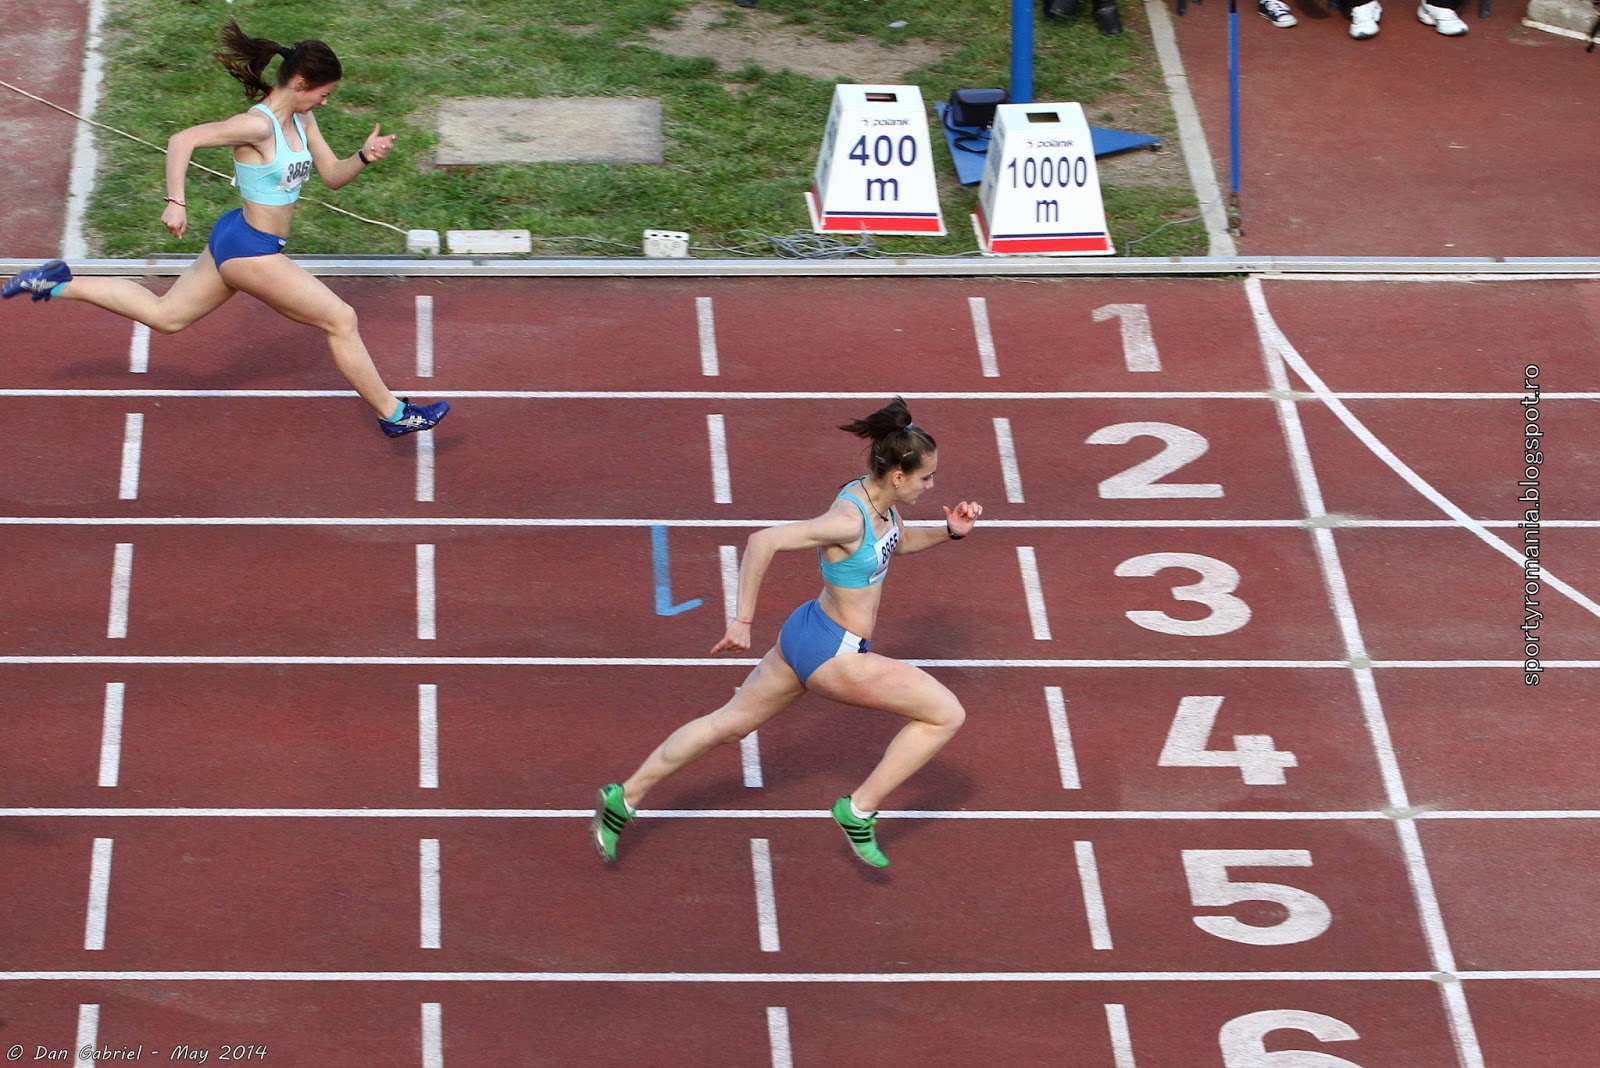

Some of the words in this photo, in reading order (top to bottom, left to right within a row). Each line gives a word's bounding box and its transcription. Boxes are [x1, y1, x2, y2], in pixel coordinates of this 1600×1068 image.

[287, 160, 311, 183] 386
[849, 135, 917, 167] 400
[1008, 156, 1087, 188] 10000
[866, 178, 898, 201] m
[1036, 199, 1059, 223] m
[1091, 303, 1162, 373] 1
[1084, 421, 1225, 499] 2
[1114, 552, 1252, 636] 3
[1157, 695, 1298, 785] 4
[1181, 849, 1332, 946] 5
[1218, 1009, 1361, 1068] 6
